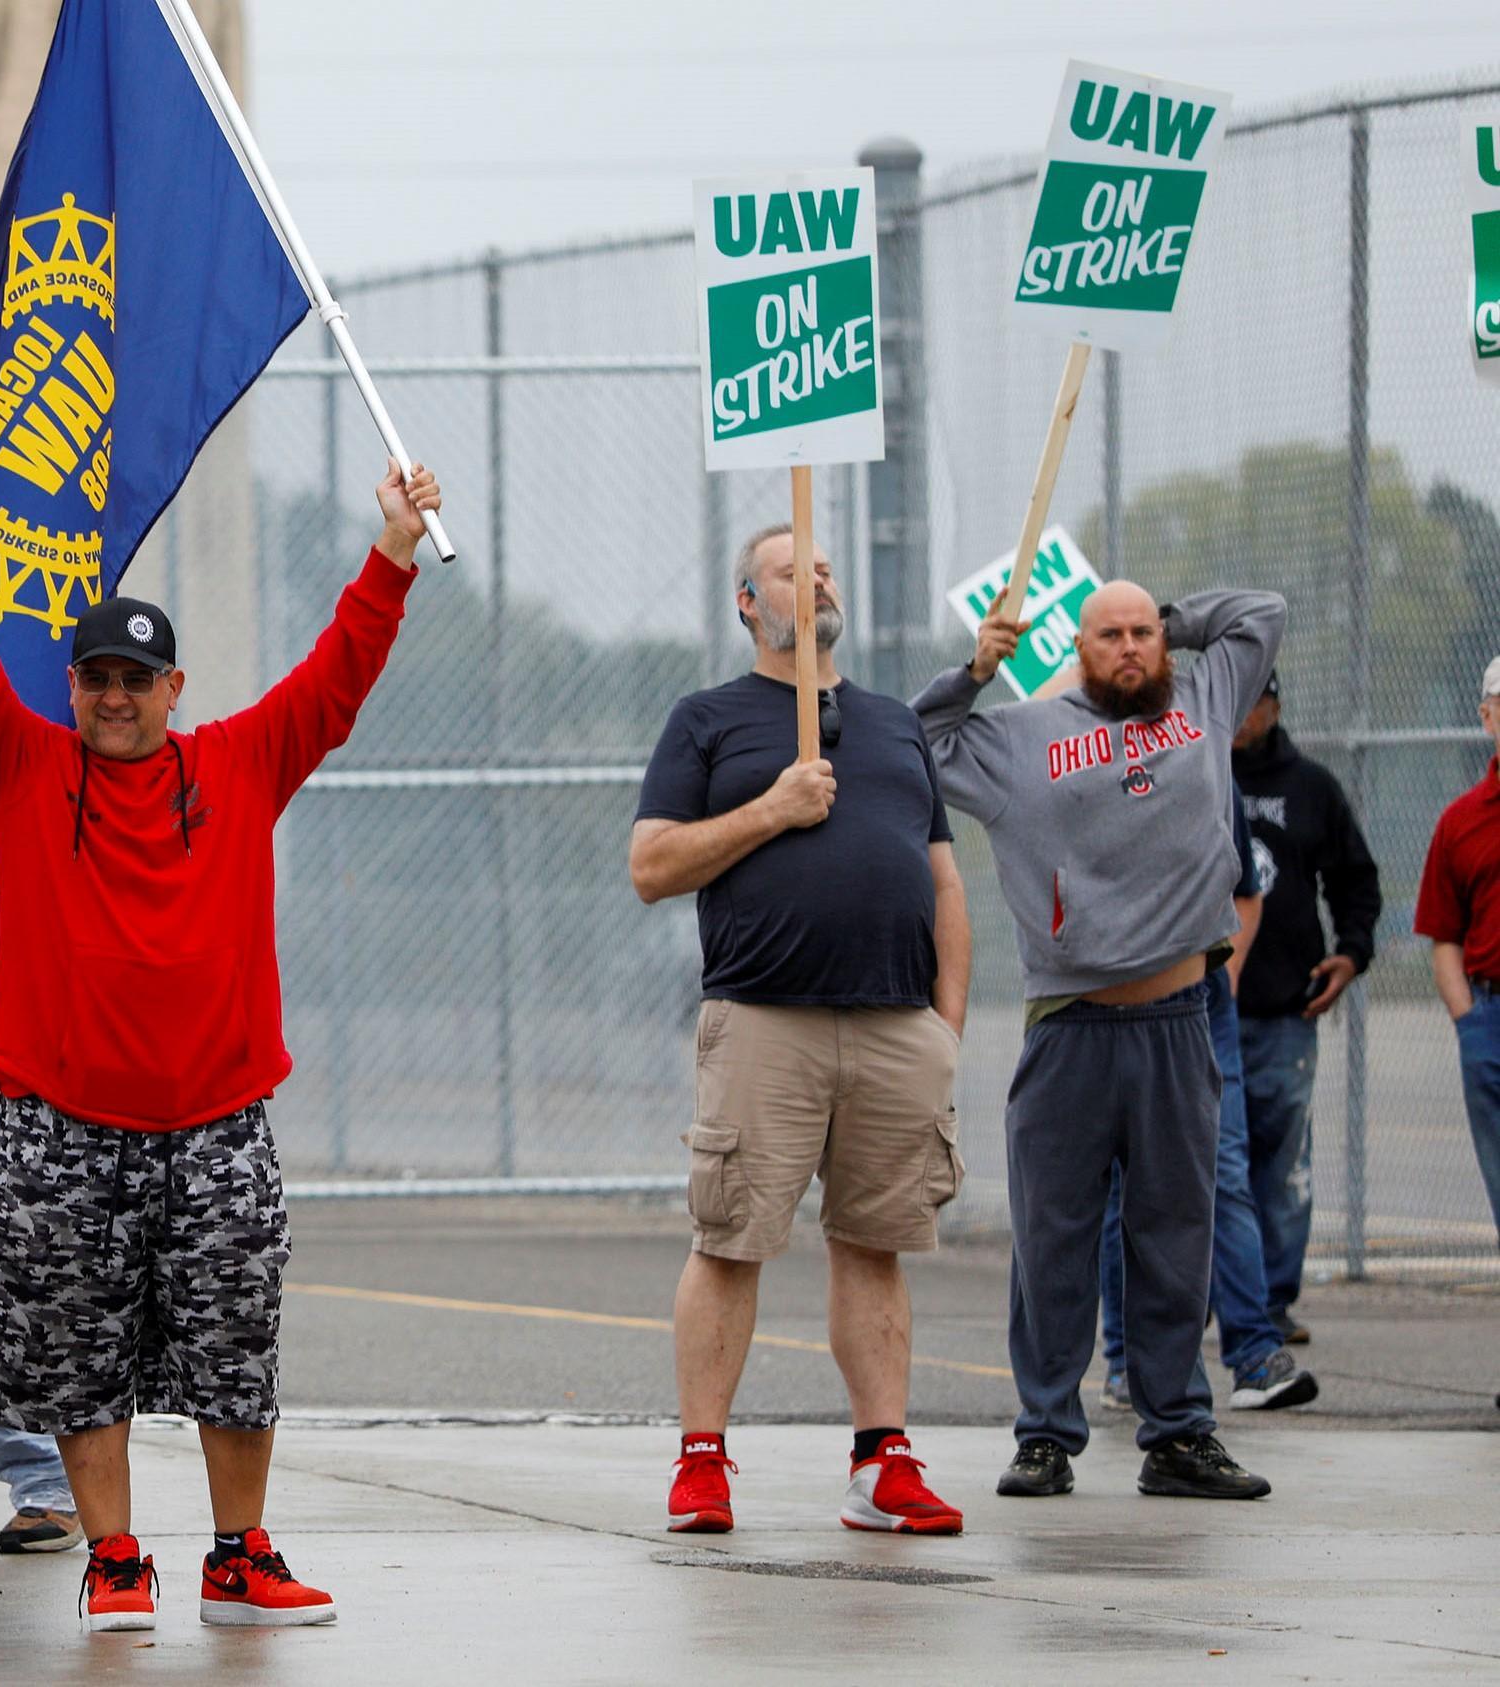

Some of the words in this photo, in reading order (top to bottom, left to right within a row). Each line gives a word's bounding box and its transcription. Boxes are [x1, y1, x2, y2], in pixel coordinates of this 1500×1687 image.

[1070, 80, 1215, 160] UAW
[713, 188, 859, 257] UAW
[1082, 175, 1152, 233] ON
[1020, 225, 1191, 296] STRIKE
[755, 275, 818, 350] ON
[712, 315, 872, 434] STRIKE
[1048, 725, 1113, 782] OHIO
[1123, 709, 1203, 760] STATE
